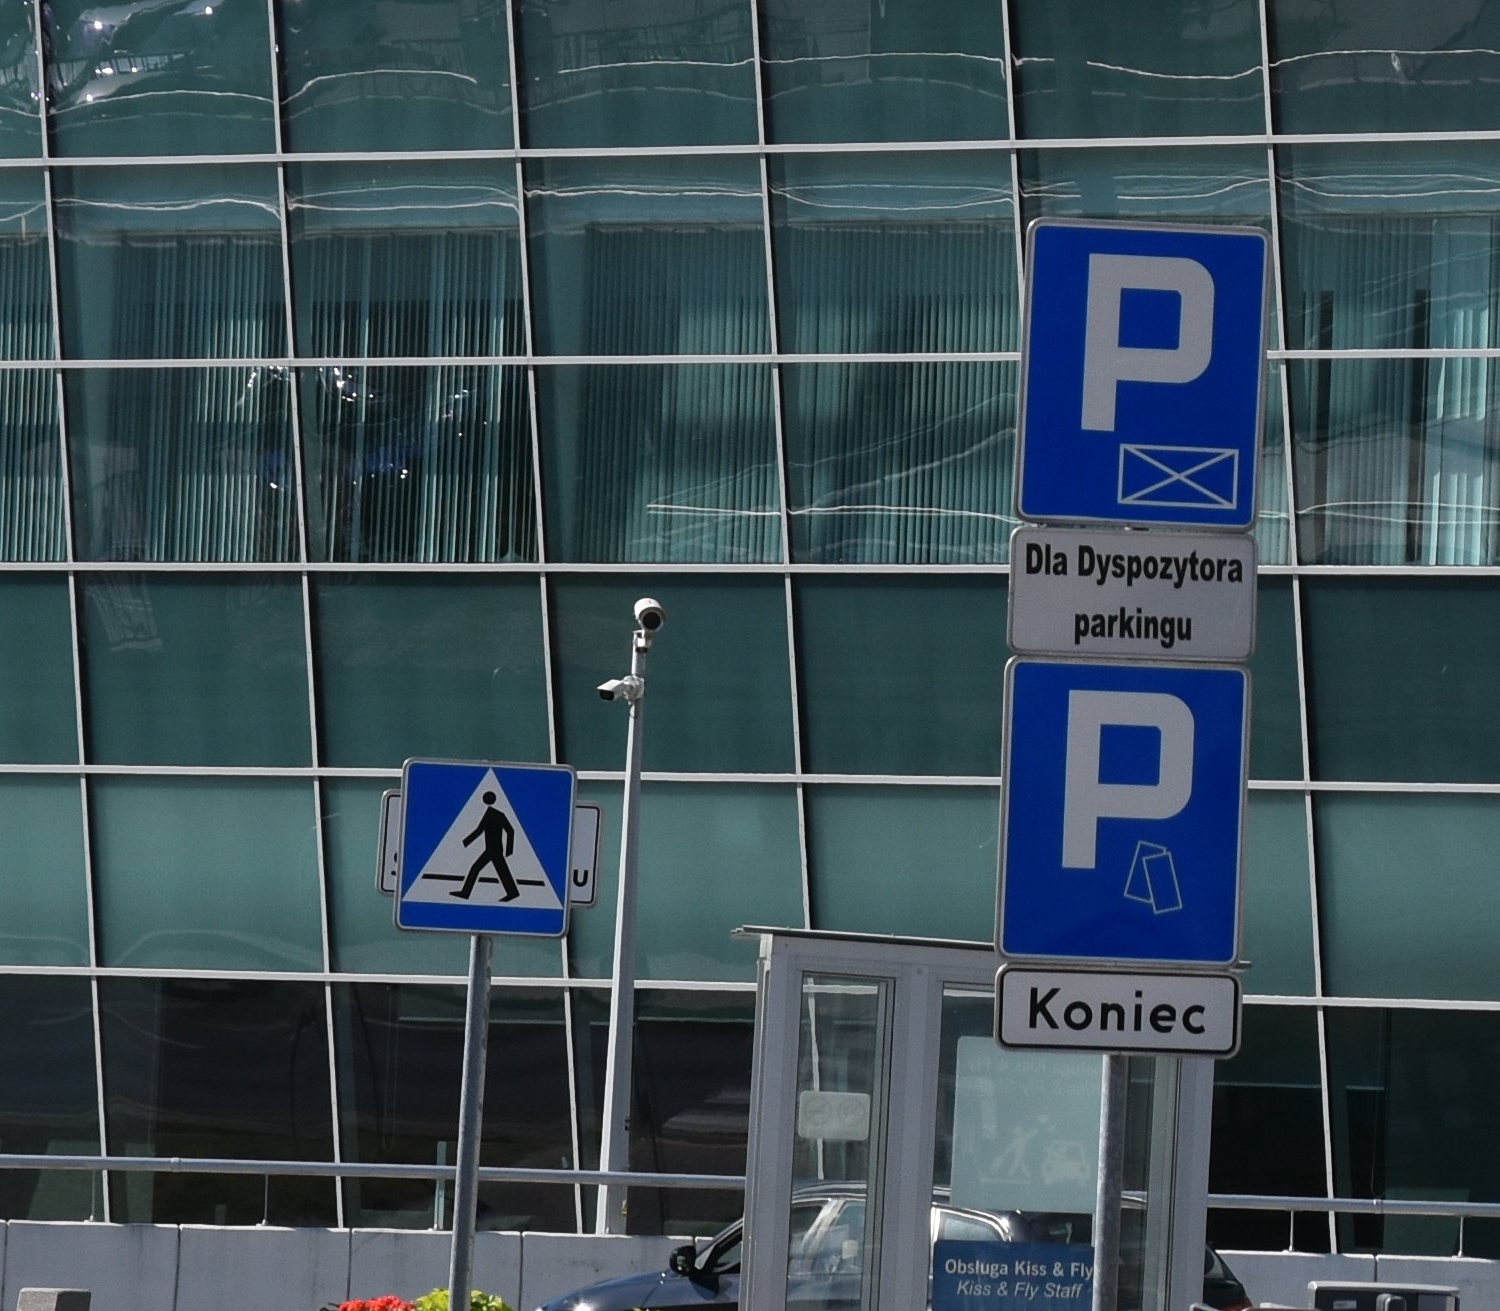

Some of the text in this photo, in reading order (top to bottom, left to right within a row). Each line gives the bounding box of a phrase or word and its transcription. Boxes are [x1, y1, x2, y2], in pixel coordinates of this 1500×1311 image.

[1081, 253, 1215, 432] P
[1026, 543, 1243, 588] Dla Dyspozytora
[1074, 607, 1193, 649] parkingu
[1062, 689, 1195, 869] P
[1029, 987, 1206, 1035] Koniec
[945, 1259, 1093, 1280] Obsługa Kiss & Fly
[957, 1280, 1083, 1301] Kiss & Fly Staff
